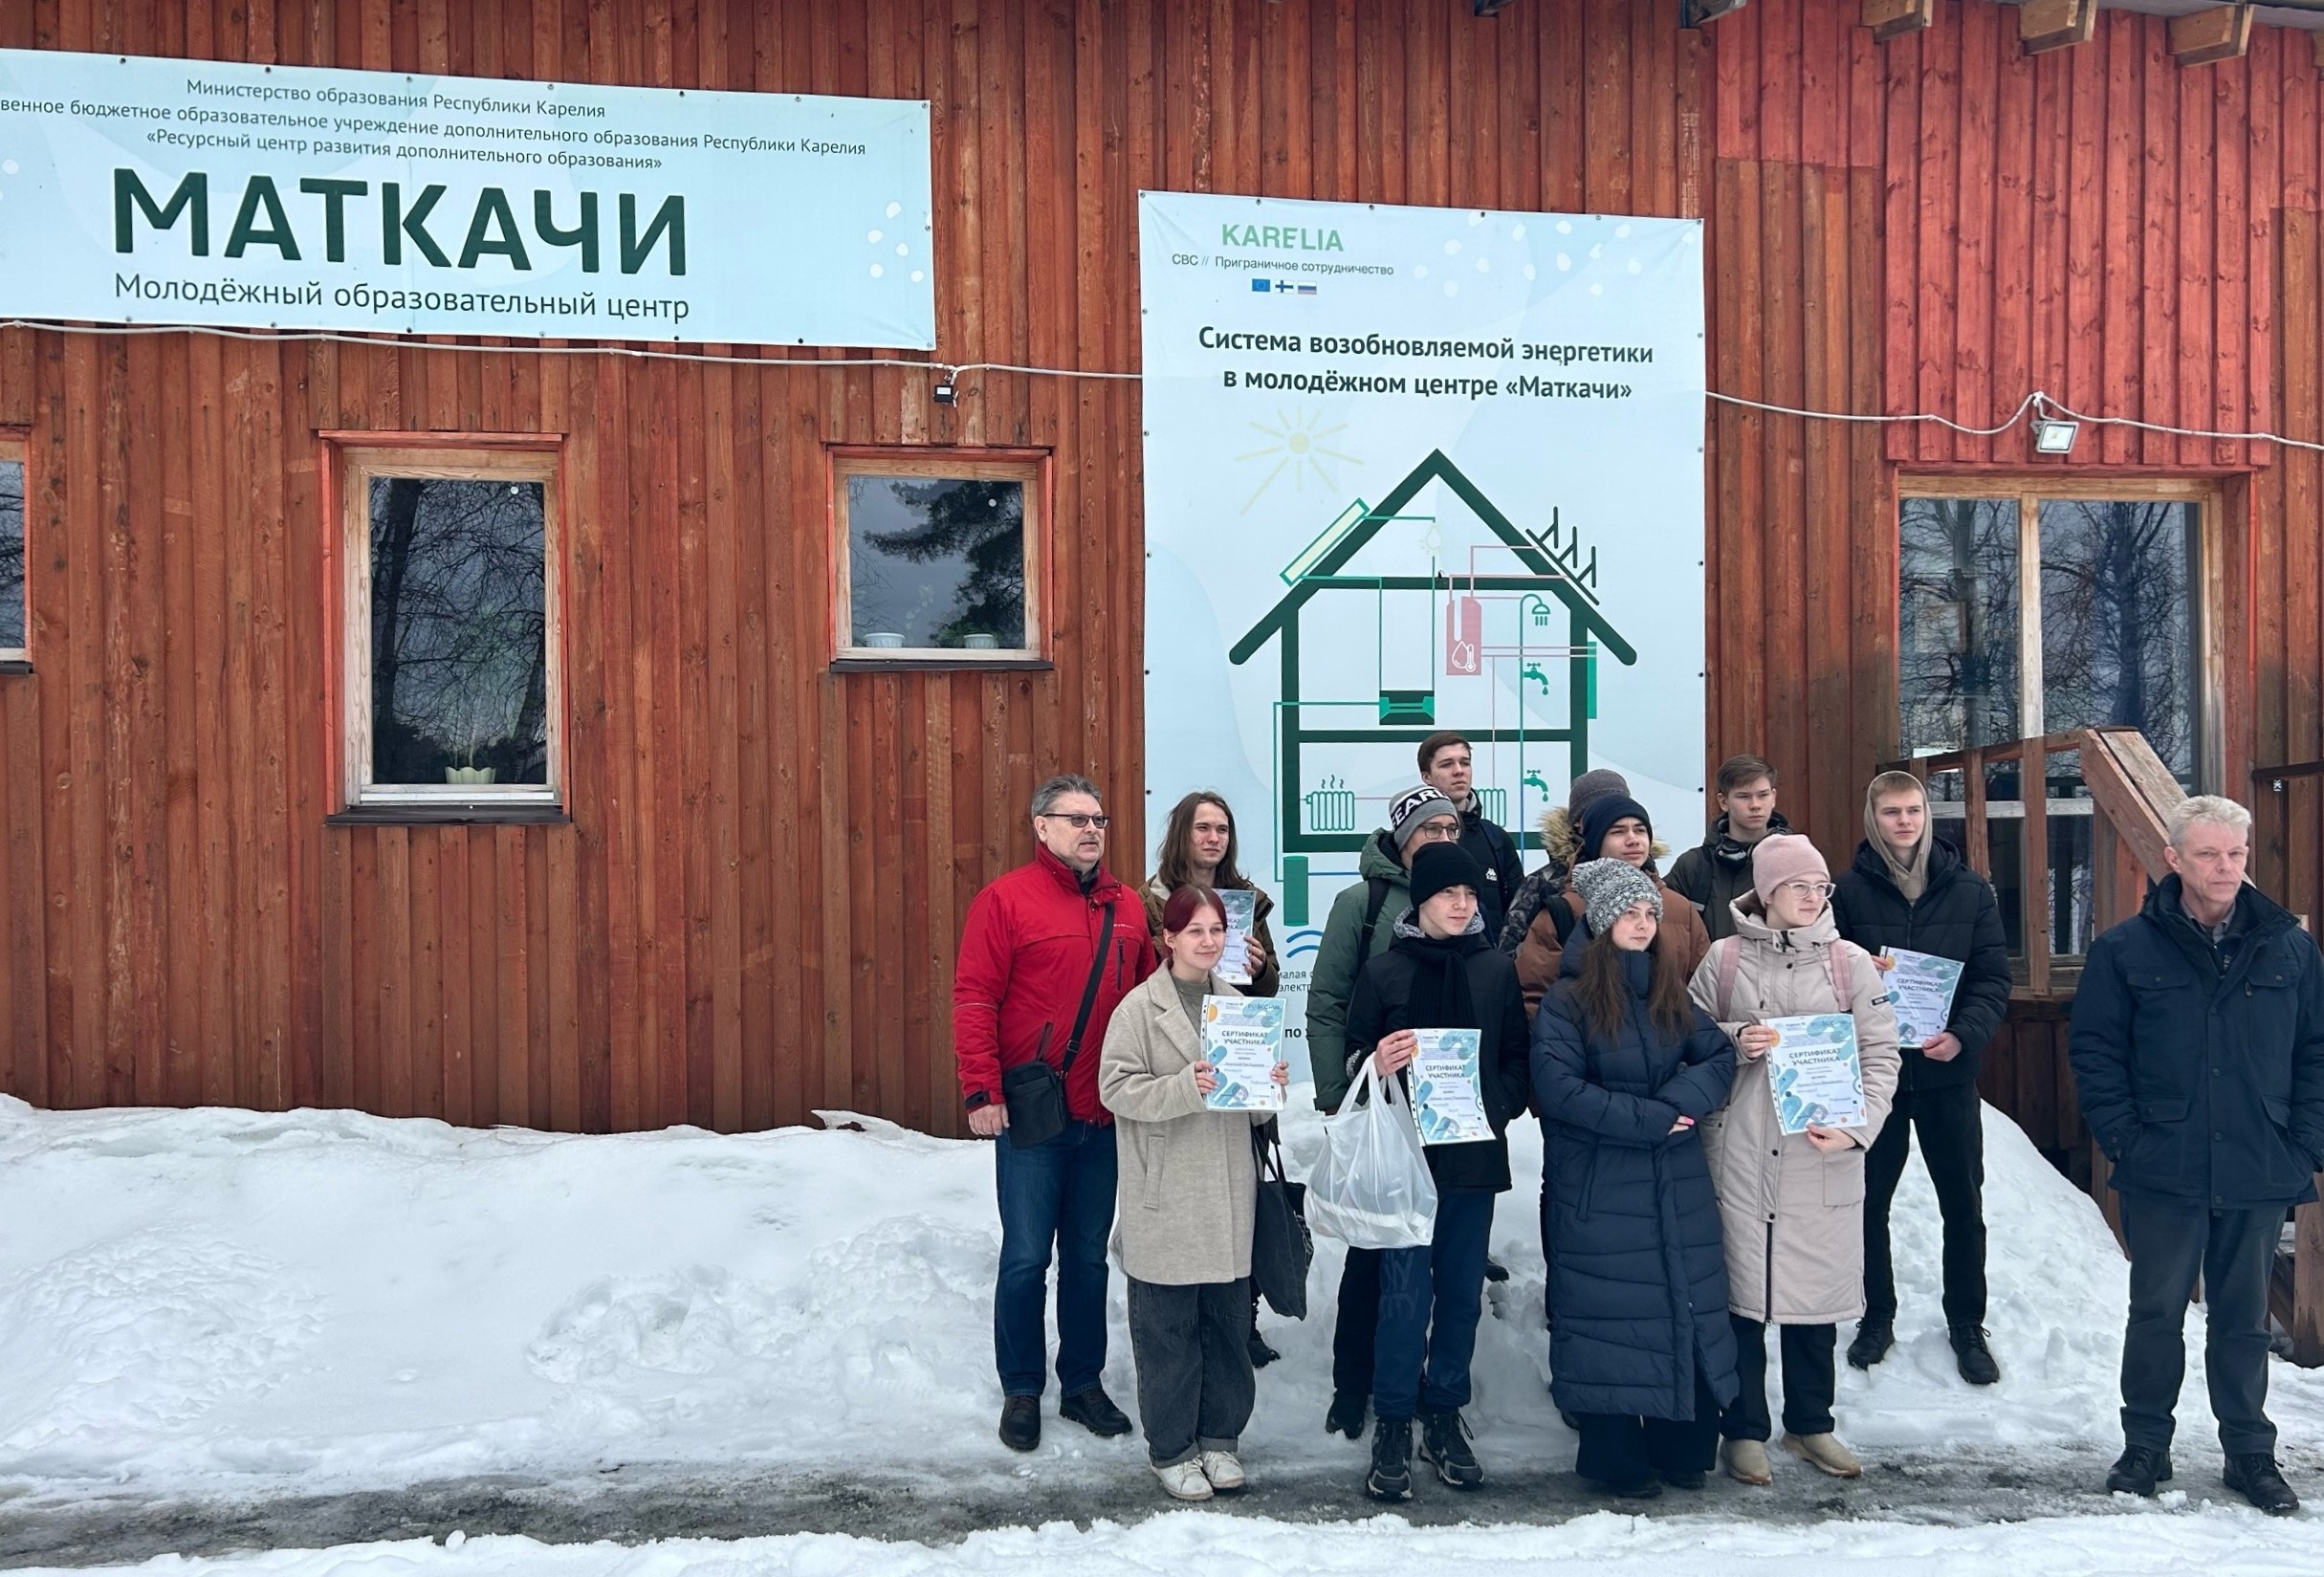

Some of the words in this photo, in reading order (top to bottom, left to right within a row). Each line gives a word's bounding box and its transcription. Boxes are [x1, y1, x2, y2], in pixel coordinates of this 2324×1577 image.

[187, 79, 310, 101] Министерство
[317, 87, 428, 108] образования
[434, 94, 530, 115] Республики
[537, 99, 604, 119] Карелия
[71, 99, 171, 120] бюджетное
[177, 106, 328, 129] образовательное
[334, 118, 438, 136] учреждение
[444, 124, 588, 142] дополнительного
[594, 130, 697, 148] образования
[704, 133, 795, 153] Республики
[801, 138, 865, 156] Карелия
[147, 128, 250, 150] «Ресурсный
[257, 138, 307, 155] центр
[314, 141, 390, 156] развития
[396, 145, 541, 164] дополнительного
[548, 150, 662, 169] образования»
[114, 168, 686, 275] МАТКАЧИ
[1221, 223, 1345, 252] KARELIA
[1216, 255, 1298, 272] Приграничное
[1302, 262, 1393, 275] сотрудничество
[116, 273, 321, 306] Молодёжный
[335, 282, 595, 316] образовательный
[608, 298, 689, 325] центр
[1199, 326, 1301, 352] Система
[1310, 333, 1514, 360] возобновляемой
[1522, 343, 1653, 366] энергетики
[1224, 371, 1237, 388] в
[1245, 369, 1406, 395] молодёжном
[1414, 378, 1498, 401] центре
[1506, 375, 1632, 399] «Маткачи»
[1221, 1030, 1268, 1039] СЕРТИФИКАТ
[1284, 1028, 1302, 1038] по
[1788, 1047, 1841, 1060] СЕРТИФИКАТ
[1792, 1056, 1841, 1065] УЧАСТНИКА
